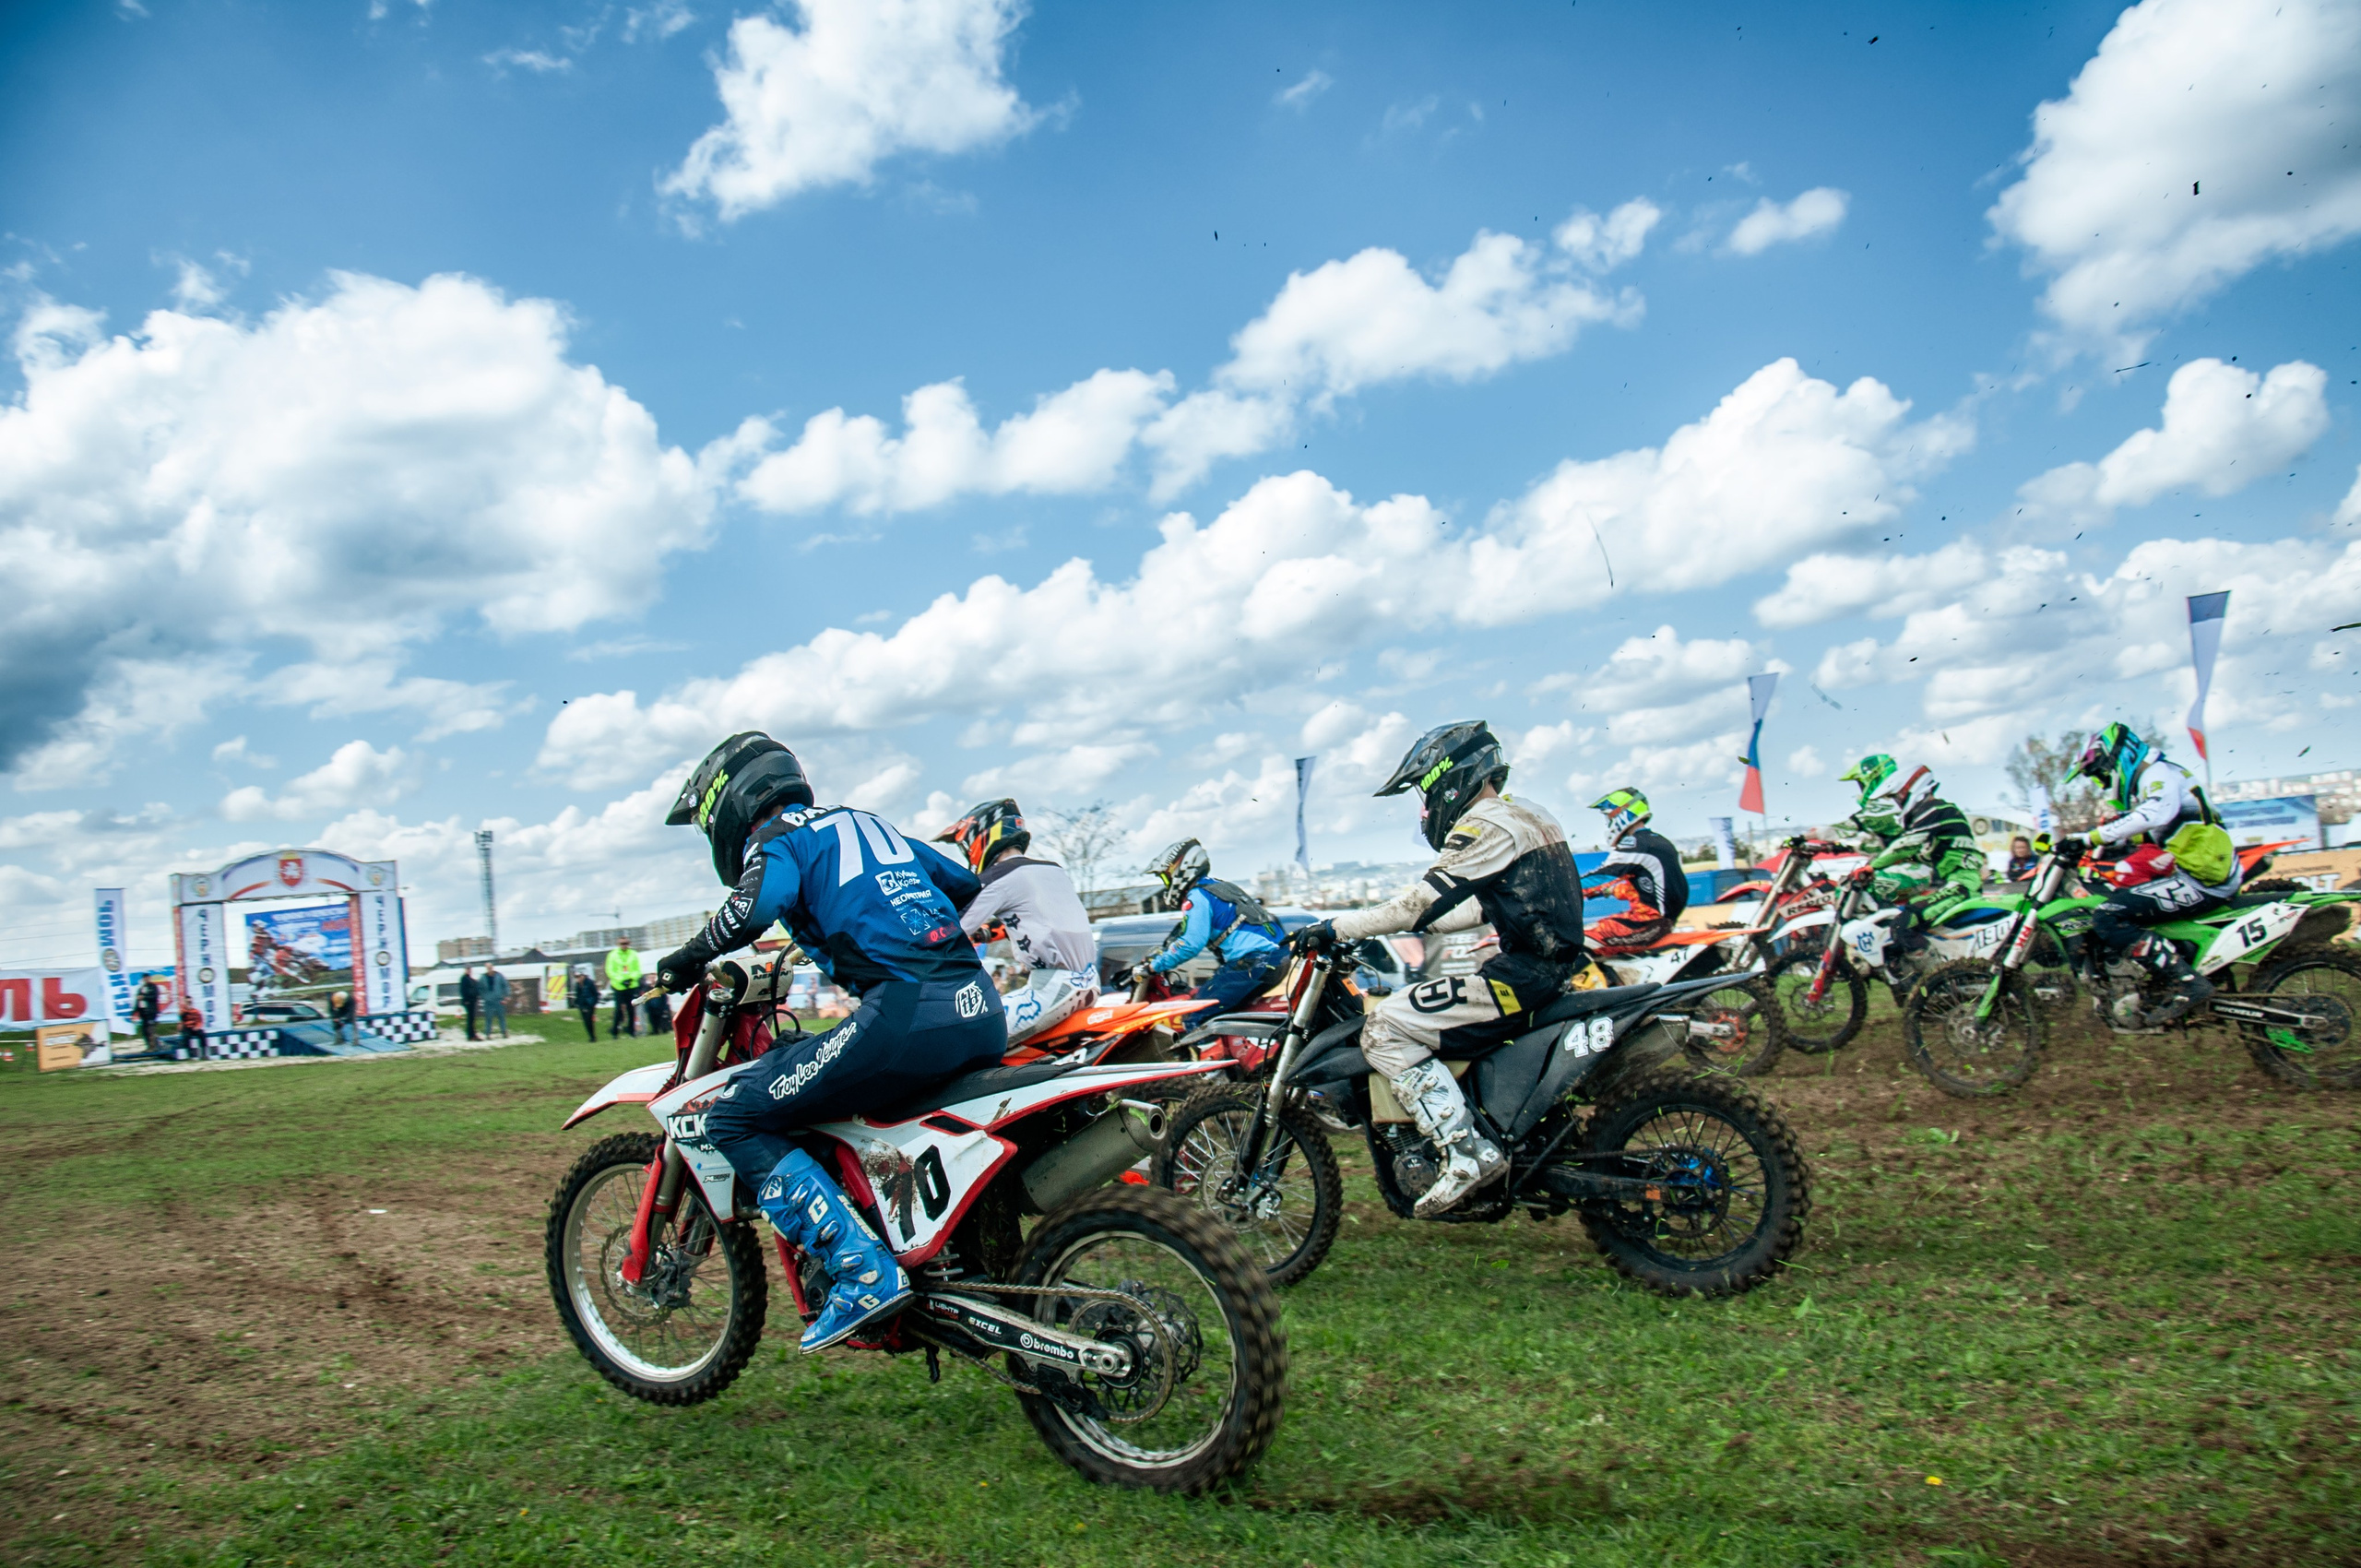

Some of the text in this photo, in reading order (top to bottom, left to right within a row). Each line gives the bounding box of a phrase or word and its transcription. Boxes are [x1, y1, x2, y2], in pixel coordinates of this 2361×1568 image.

[1420, 755, 1453, 791] 100%
[810, 811, 915, 887] 70
[2236, 917, 2267, 948] 15
[1564, 1016, 1615, 1058] 48
[968, 1316, 1003, 1336] EXCEL
[1033, 1338, 1074, 1360] brembo
